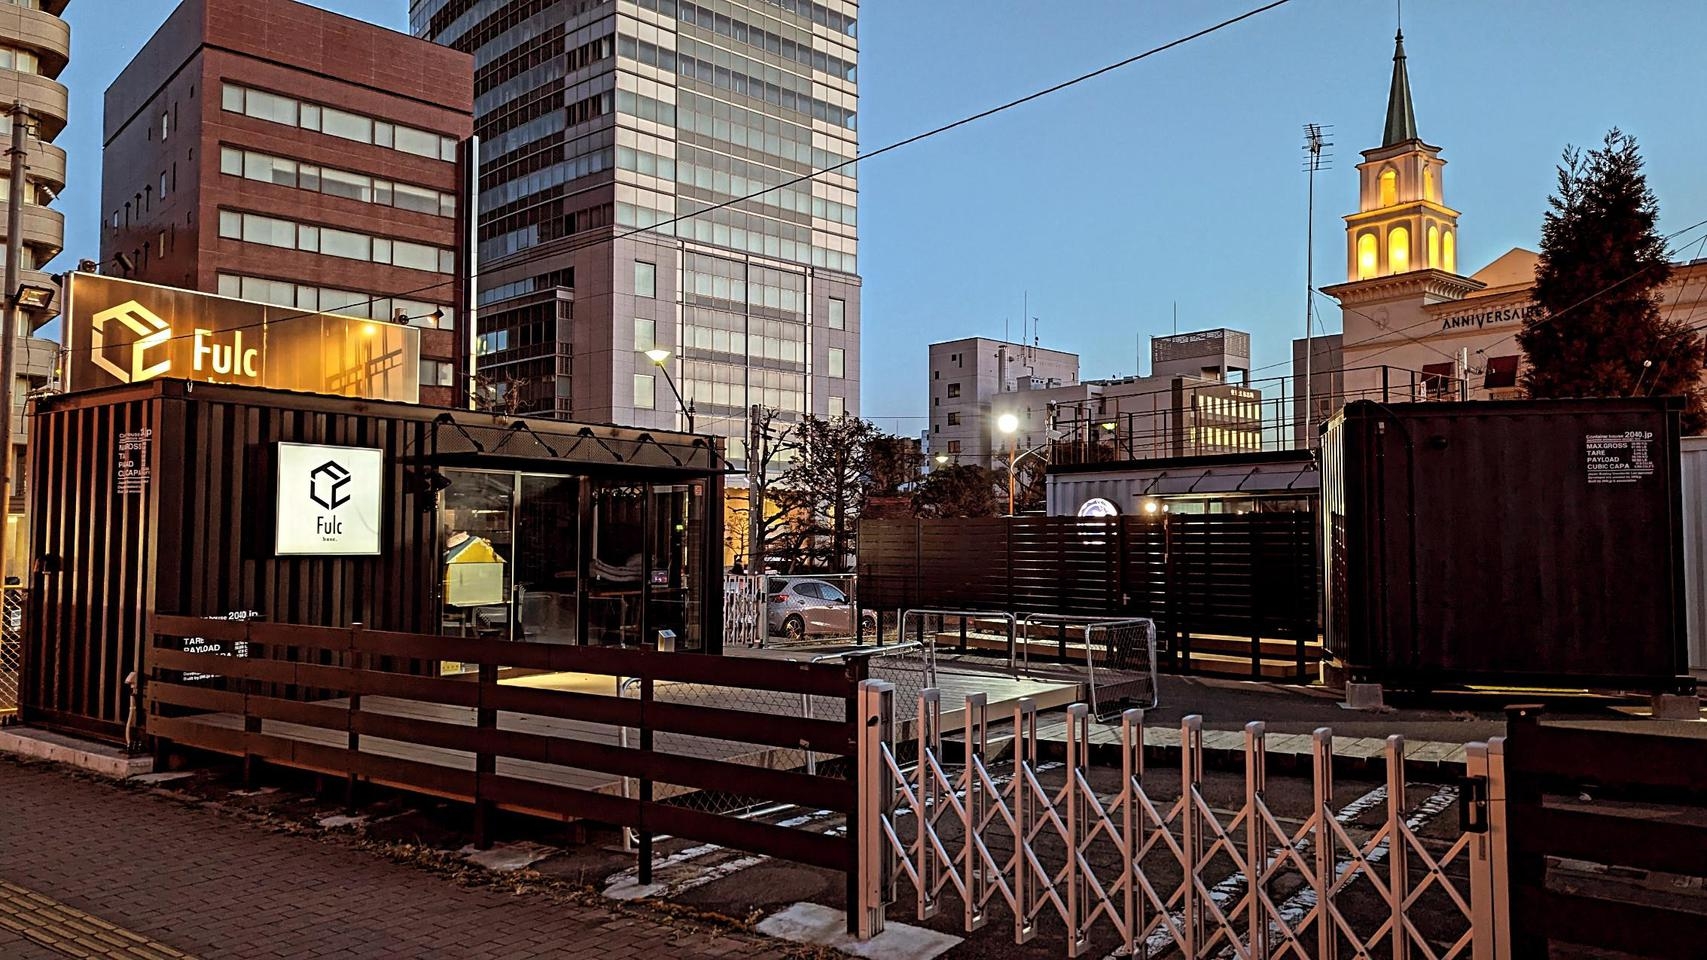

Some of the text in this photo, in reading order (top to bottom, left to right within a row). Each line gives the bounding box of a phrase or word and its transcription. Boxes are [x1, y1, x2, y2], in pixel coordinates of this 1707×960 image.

[1442, 305, 1541, 329] ANNIVERSAIR
[193, 328, 258, 377] Fulc
[1624, 431, 1653, 439] 2040.jp
[317, 514, 342, 534] Fulc
[183, 644, 221, 653] PAYLOAD
